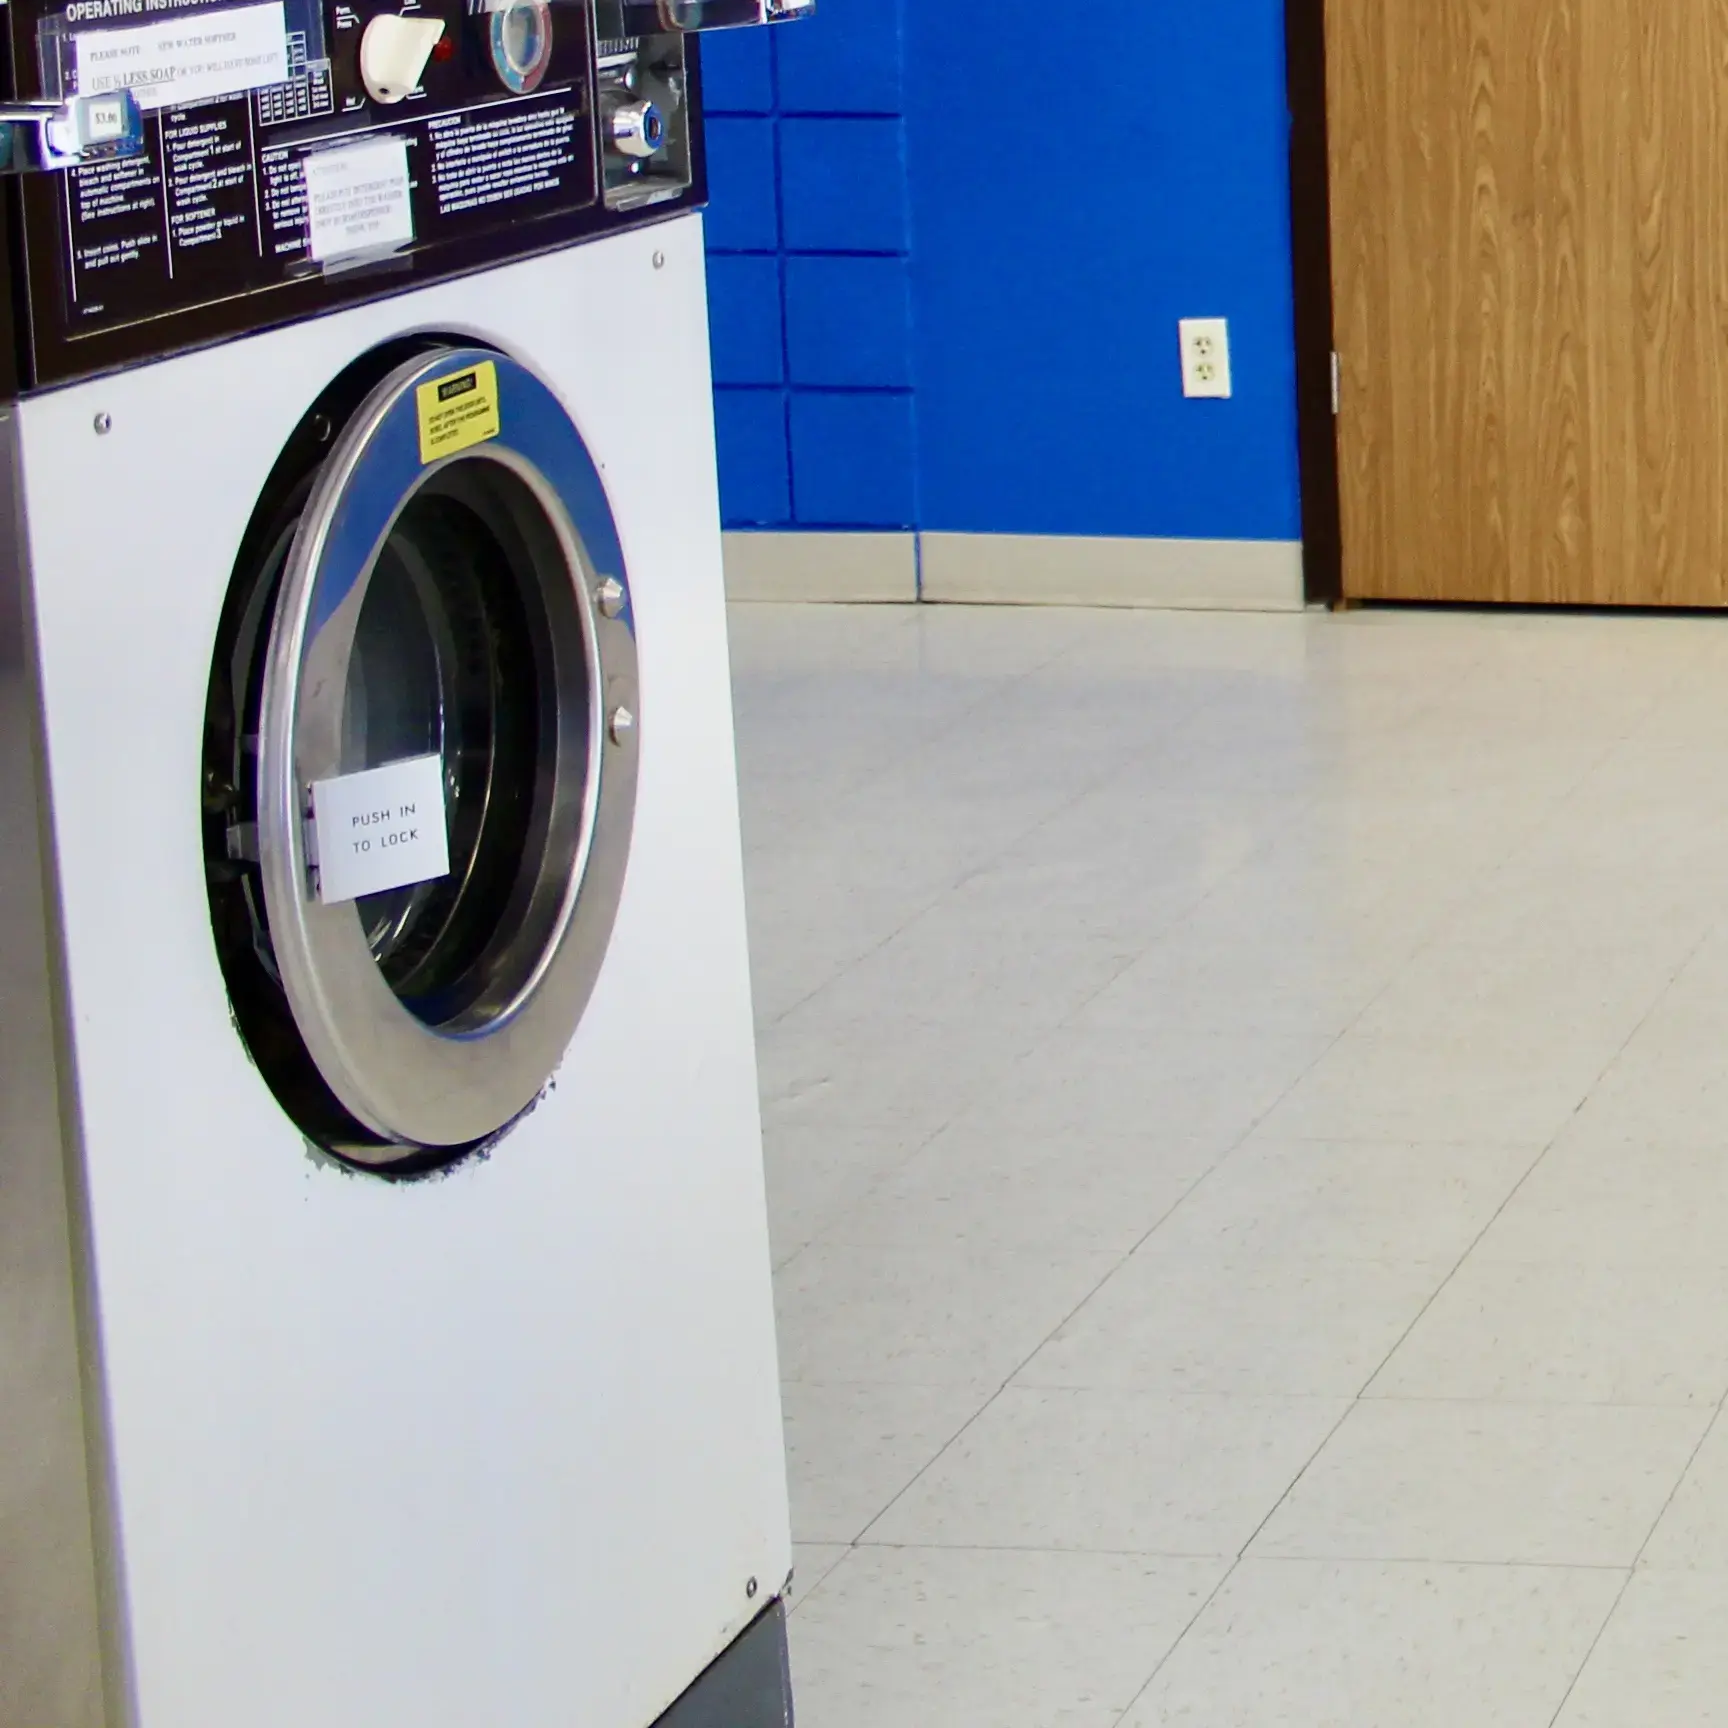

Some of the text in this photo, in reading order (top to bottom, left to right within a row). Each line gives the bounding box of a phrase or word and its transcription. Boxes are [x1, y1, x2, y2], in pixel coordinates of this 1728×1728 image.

[123, 71, 150, 86] LESS
[151, 65, 176, 80] SOAP
[352, 803, 415, 827] PUSH IN
[353, 828, 419, 853] TO LOCK
